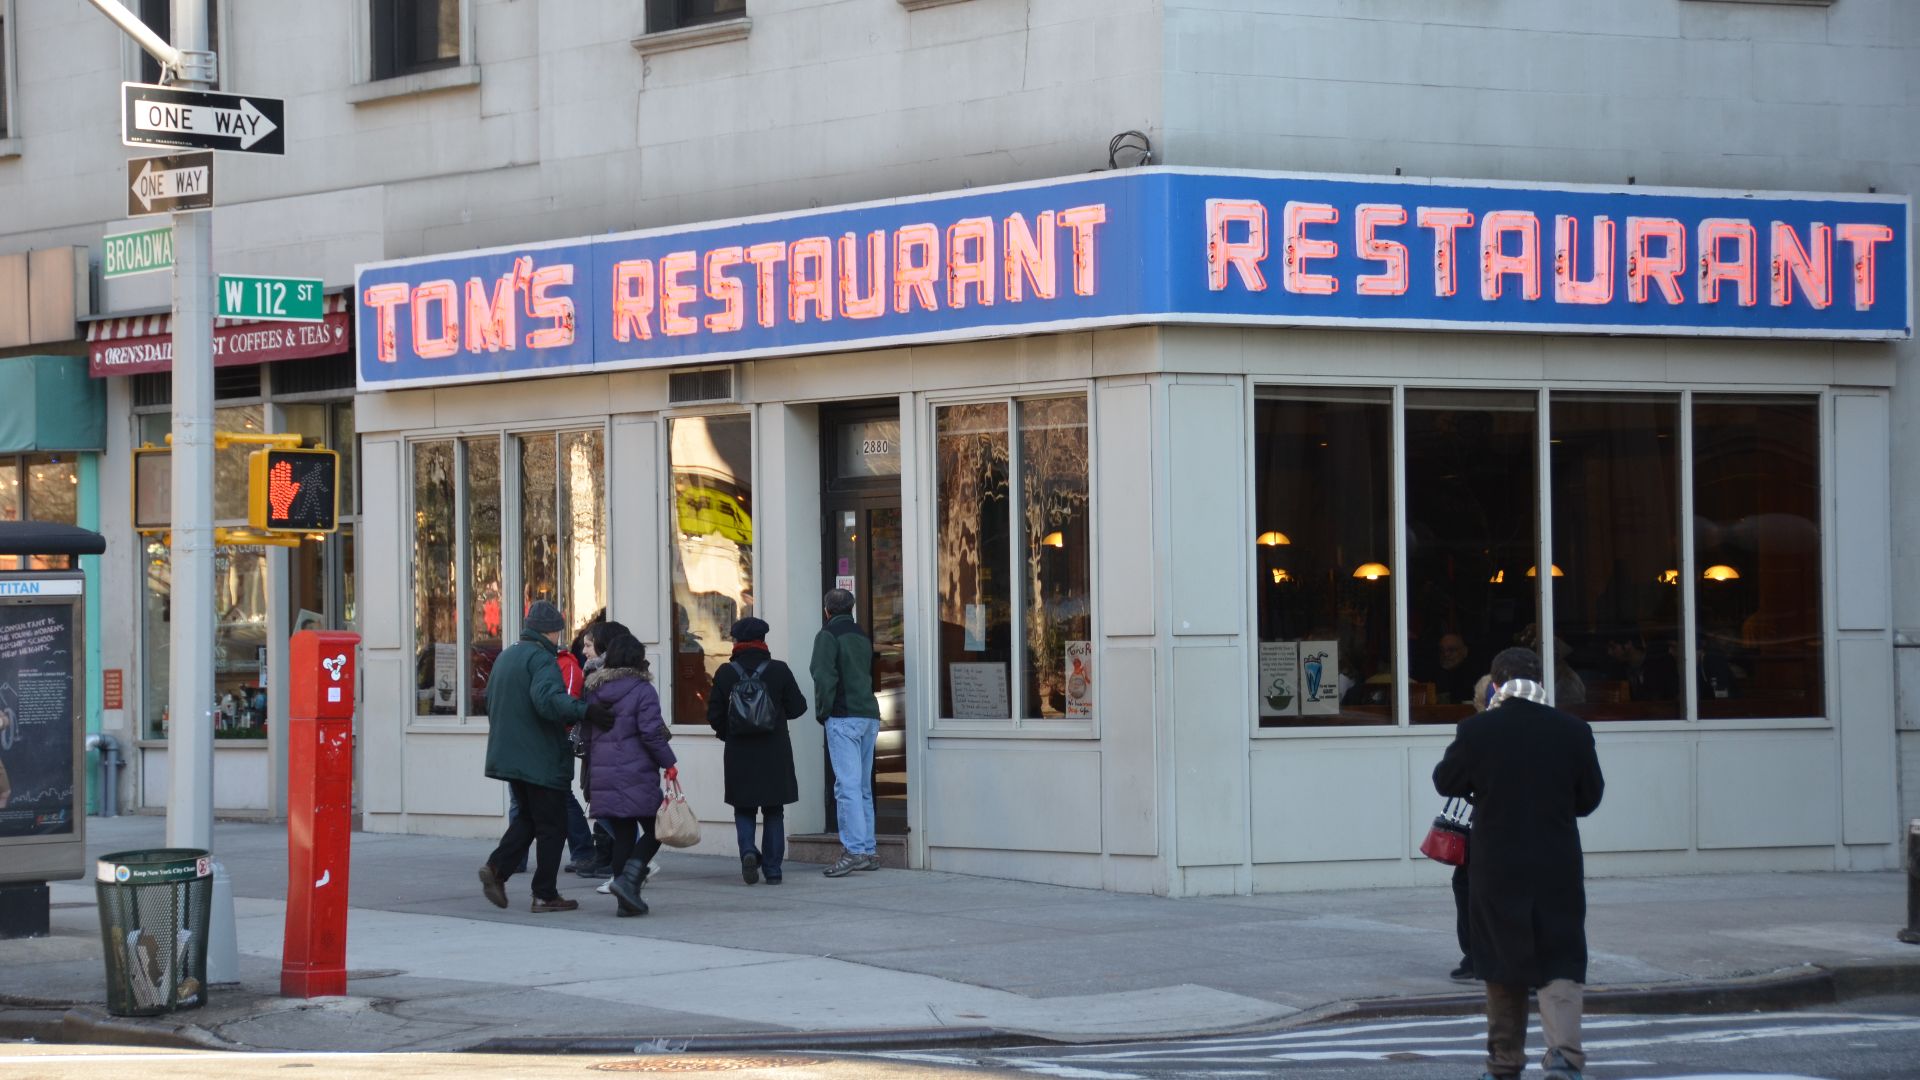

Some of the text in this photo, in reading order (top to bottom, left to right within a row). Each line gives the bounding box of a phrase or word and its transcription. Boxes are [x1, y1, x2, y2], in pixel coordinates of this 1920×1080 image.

[149, 105, 260, 136] ONE WAY
[140, 169, 202, 197] ONE WAY
[106, 231, 173, 273] BROADWA
[1205, 196, 1895, 312] RESTAURANT
[224, 281, 314, 315] W 112 ST
[363, 203, 1107, 364] TOM'S RESTAURANT
[144, 343, 173, 362] DAIL
[229, 329, 282, 354] COFFEES
[285, 328, 296, 347] &
[299, 324, 330, 346] TEAS
[863, 440, 889, 454] 2880
[0, 581, 40, 594] TITAN
[173, 866, 183, 874] City
